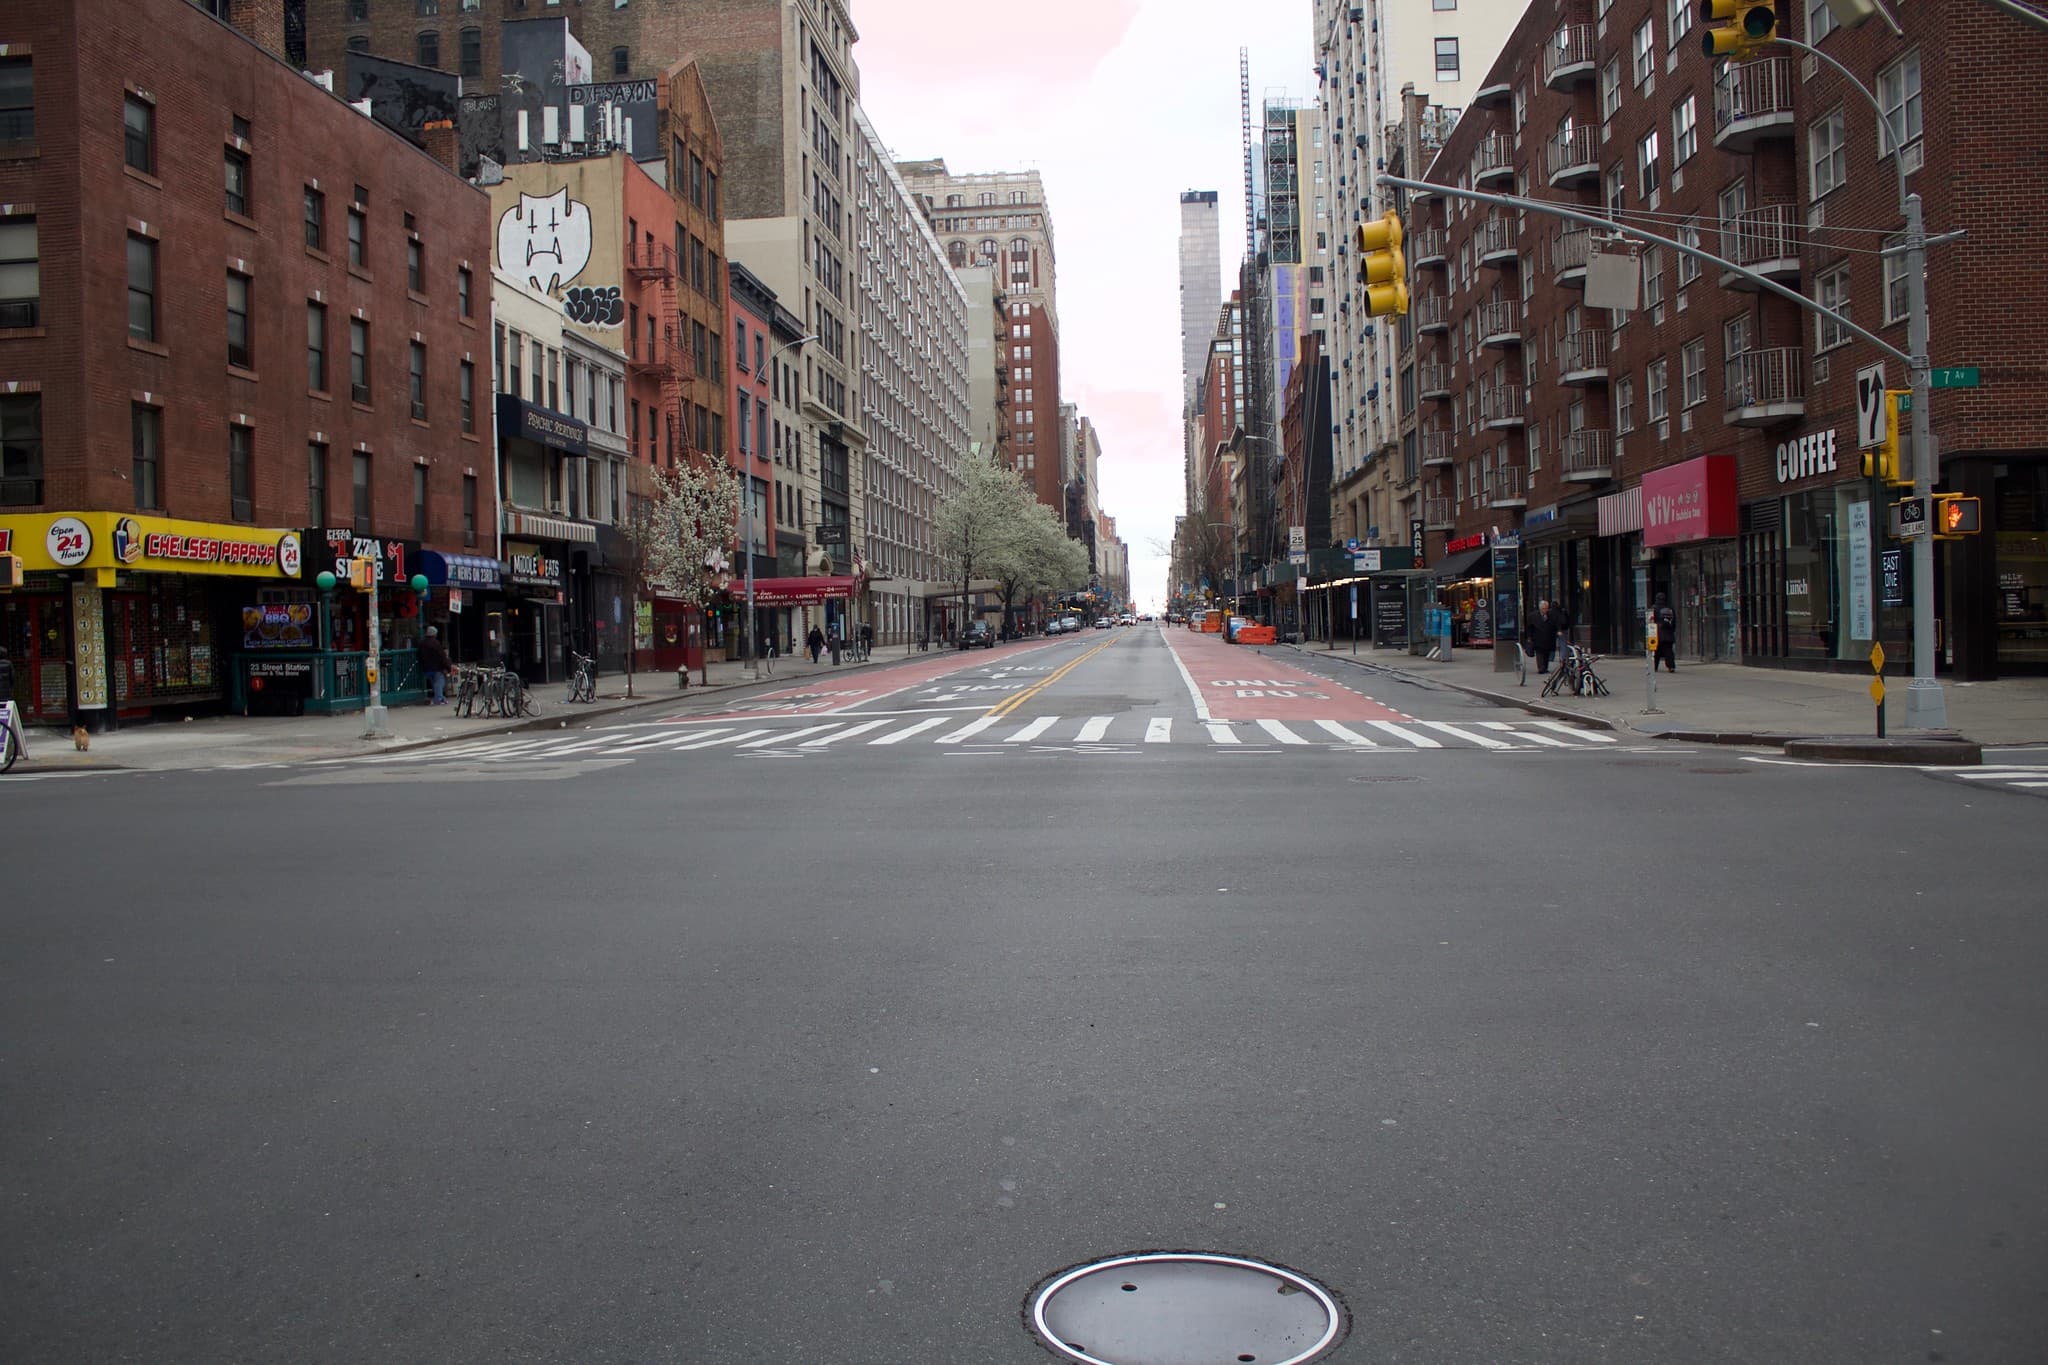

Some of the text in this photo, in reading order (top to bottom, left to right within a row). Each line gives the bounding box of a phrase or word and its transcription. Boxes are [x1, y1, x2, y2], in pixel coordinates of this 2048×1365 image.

[1944, 370, 1964, 384] 7 Av
[1776, 429, 1837, 483] COFFEE
[51, 526, 74, 537] Open
[1901, 522, 1924, 534] BIKE LANE
[57, 534, 83, 551] 24
[1413, 522, 1422, 556] PARK
[61, 548, 84, 559] Hours
[148, 534, 276, 565] CHELSEA PAPAYA
[285, 549, 297, 562] 24
[545, 559, 559, 577] EATS
[1883, 556, 1899, 571] EAST
[1885, 572, 1897, 587] ONE
[1786, 579, 1808, 595] Lunch
[265, 614, 289, 623] BBQ
[262, 663, 283, 671] Street
[285, 663, 310, 671] Station
[1235, 690, 1330, 699] BUS
